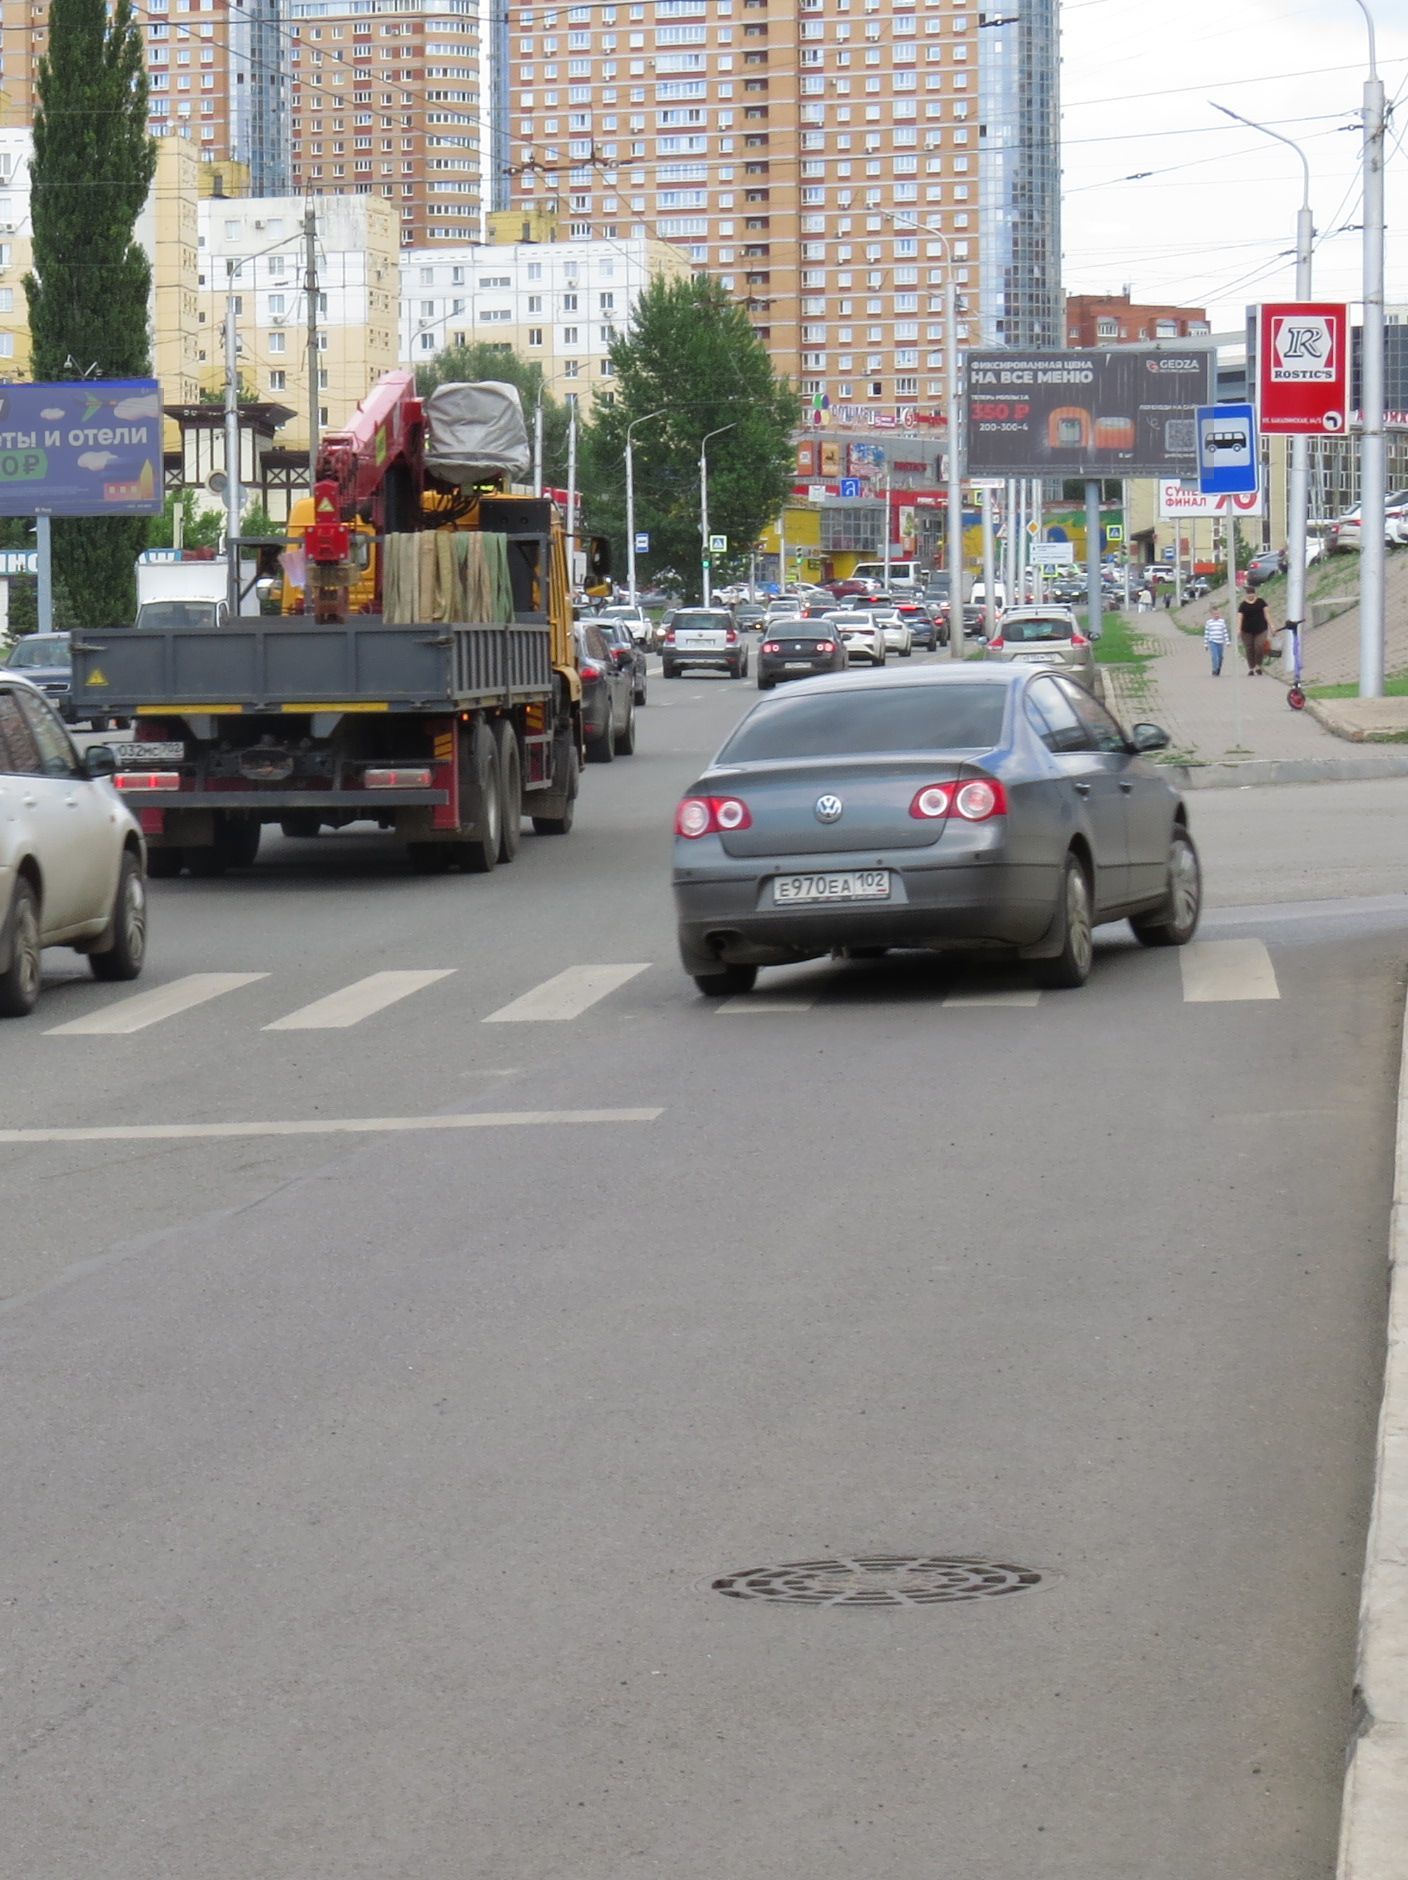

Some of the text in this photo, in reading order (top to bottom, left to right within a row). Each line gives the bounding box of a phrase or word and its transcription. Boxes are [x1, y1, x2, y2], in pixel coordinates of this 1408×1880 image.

[1064, 361, 1093, 369] ЦЕНА
[1159, 360, 1199, 369] GEDZA
[971, 371, 1093, 383] НА ВСЕ МЕНЮ
[1274, 370, 1333, 379] ROSTIC'S
[971, 404, 1008, 420] 350
[44, 430, 60, 447] и
[68, 427, 147, 447] отели
[1165, 498, 1206, 507] ФИНАЛ
